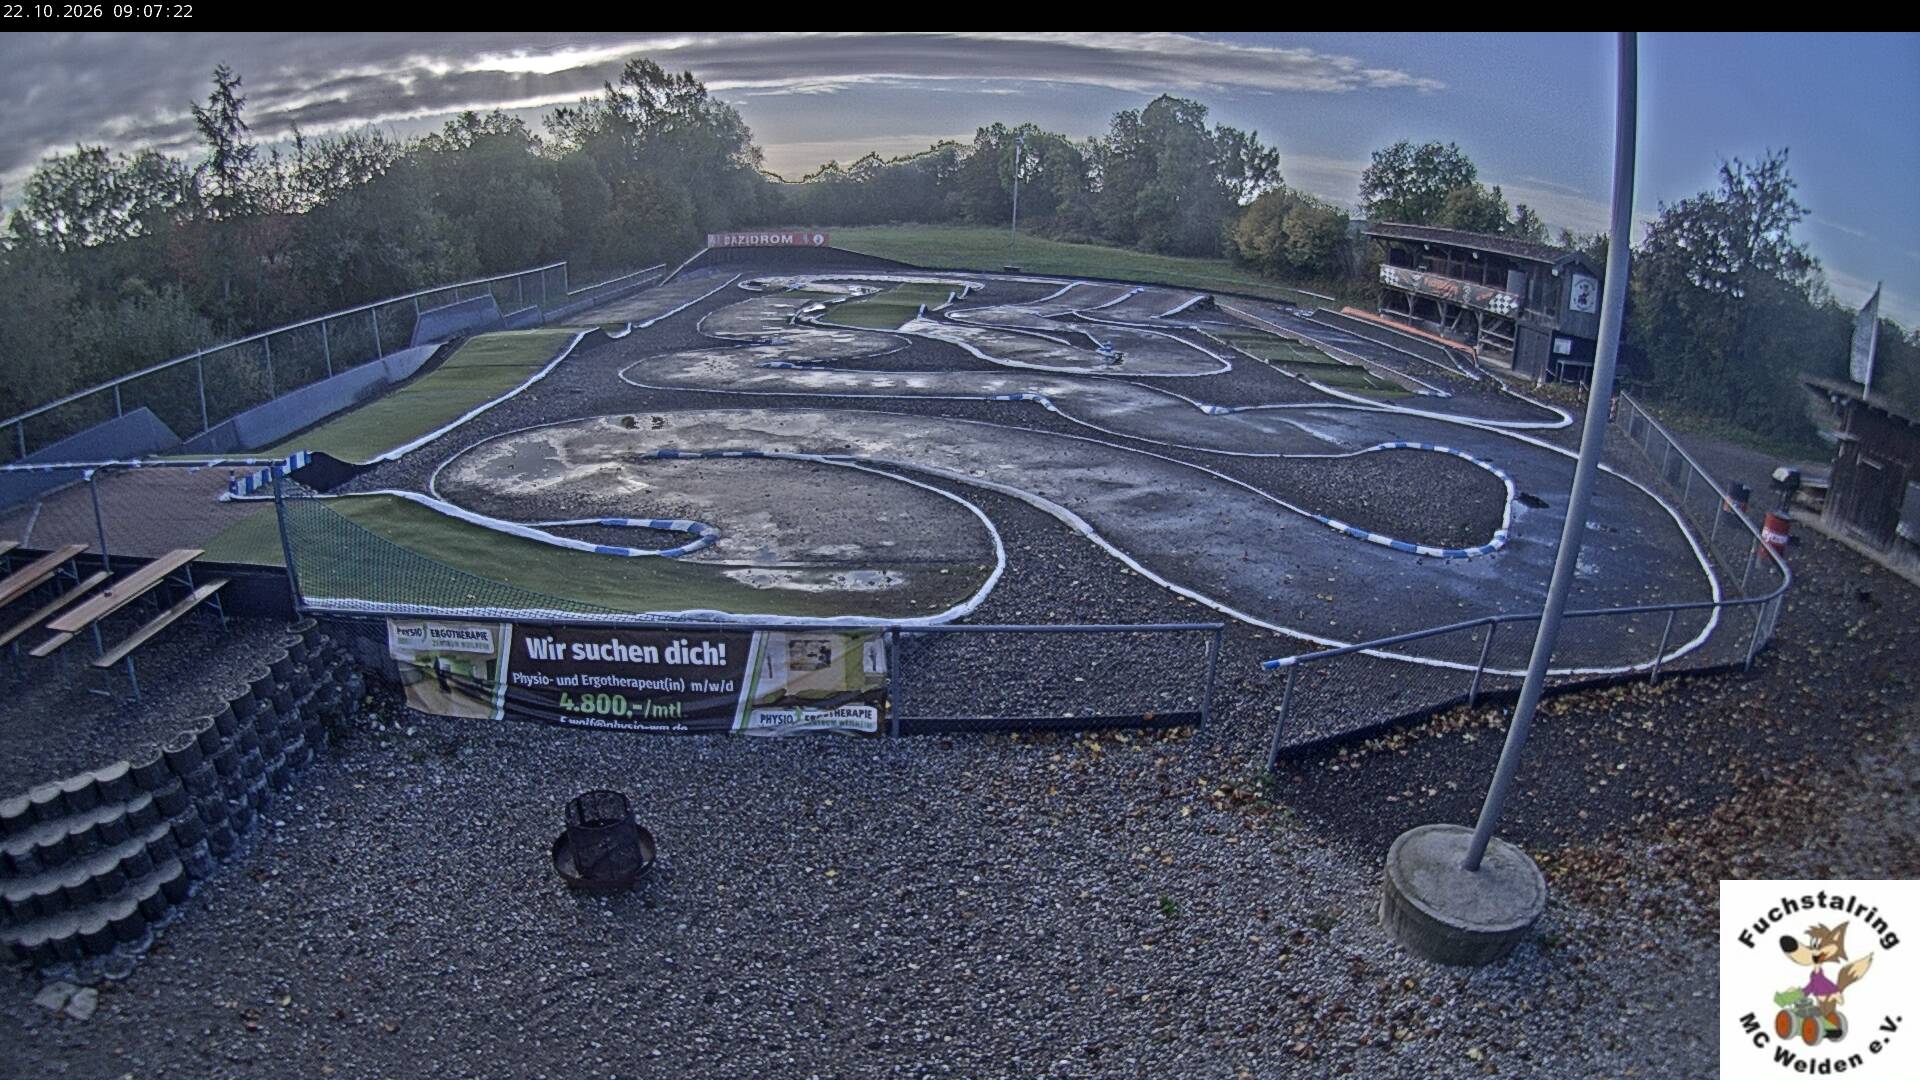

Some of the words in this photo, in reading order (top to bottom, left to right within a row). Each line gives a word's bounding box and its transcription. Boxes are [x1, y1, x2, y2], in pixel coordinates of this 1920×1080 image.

[396, 627, 423, 638] PHYSIO
[430, 628, 489, 641] ERGOTHERAPIE
[525, 636, 567, 660] Wir
[572, 638, 659, 664] suchen
[664, 639, 727, 666] dich!
[512, 672, 554, 687] Physio-
[556, 674, 579, 687] und
[581, 674, 686, 693] Ergotherapeut(in)
[691, 679, 734, 693] m/w/d
[760, 713, 794, 725] PHYSIO
